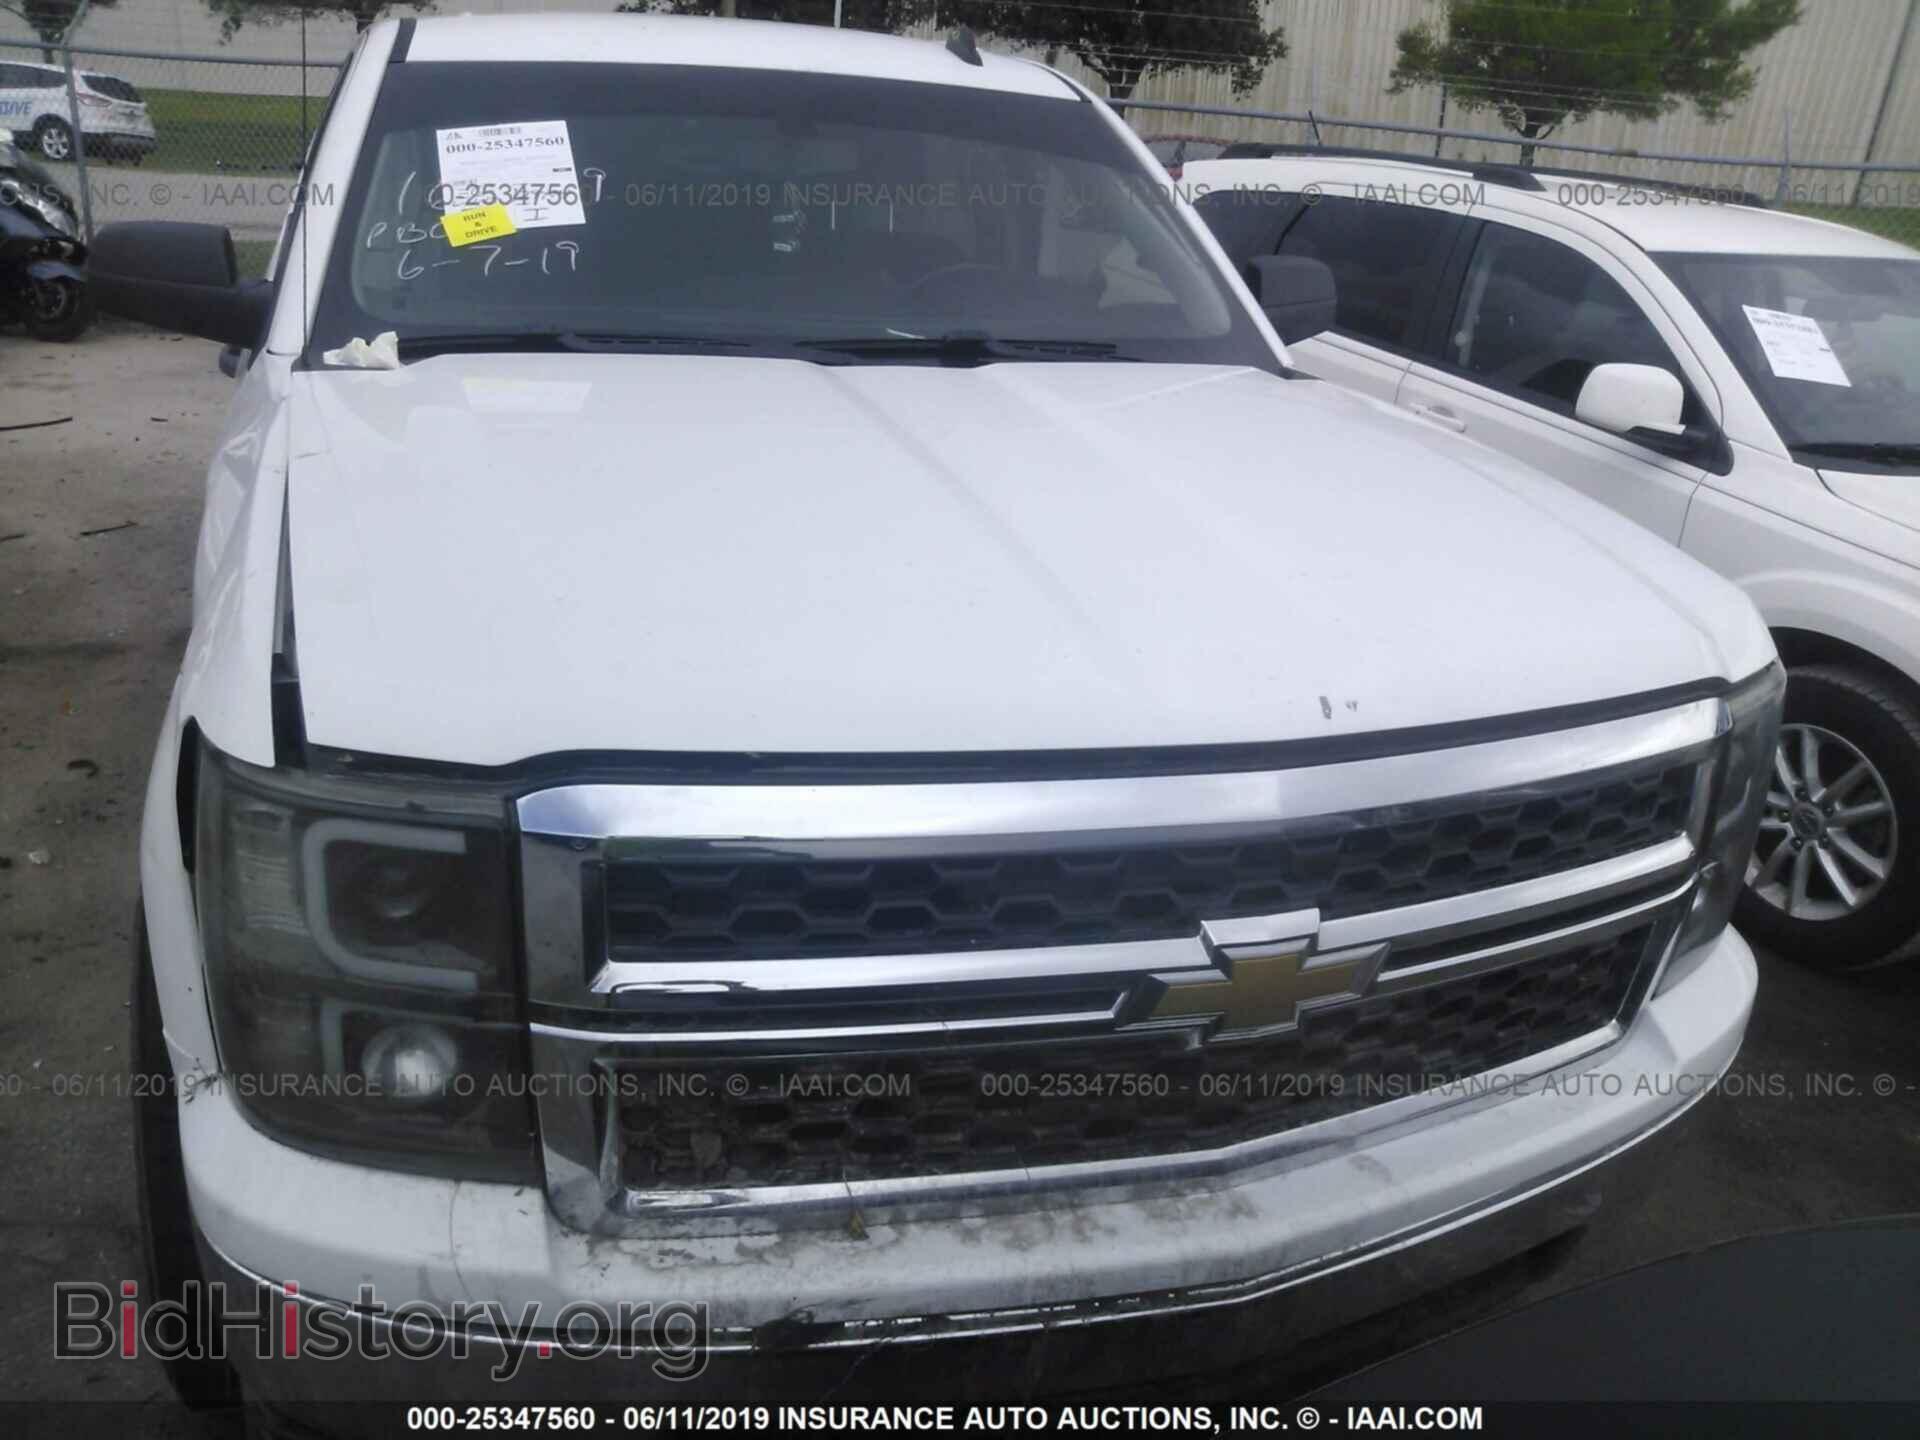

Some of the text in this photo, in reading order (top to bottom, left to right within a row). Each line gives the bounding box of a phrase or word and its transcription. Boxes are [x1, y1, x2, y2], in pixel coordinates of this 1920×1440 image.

[446, 136, 565, 154] 000-25347560
[463, 211, 486, 222] RUN
[465, 226, 498, 238] DRIVE
